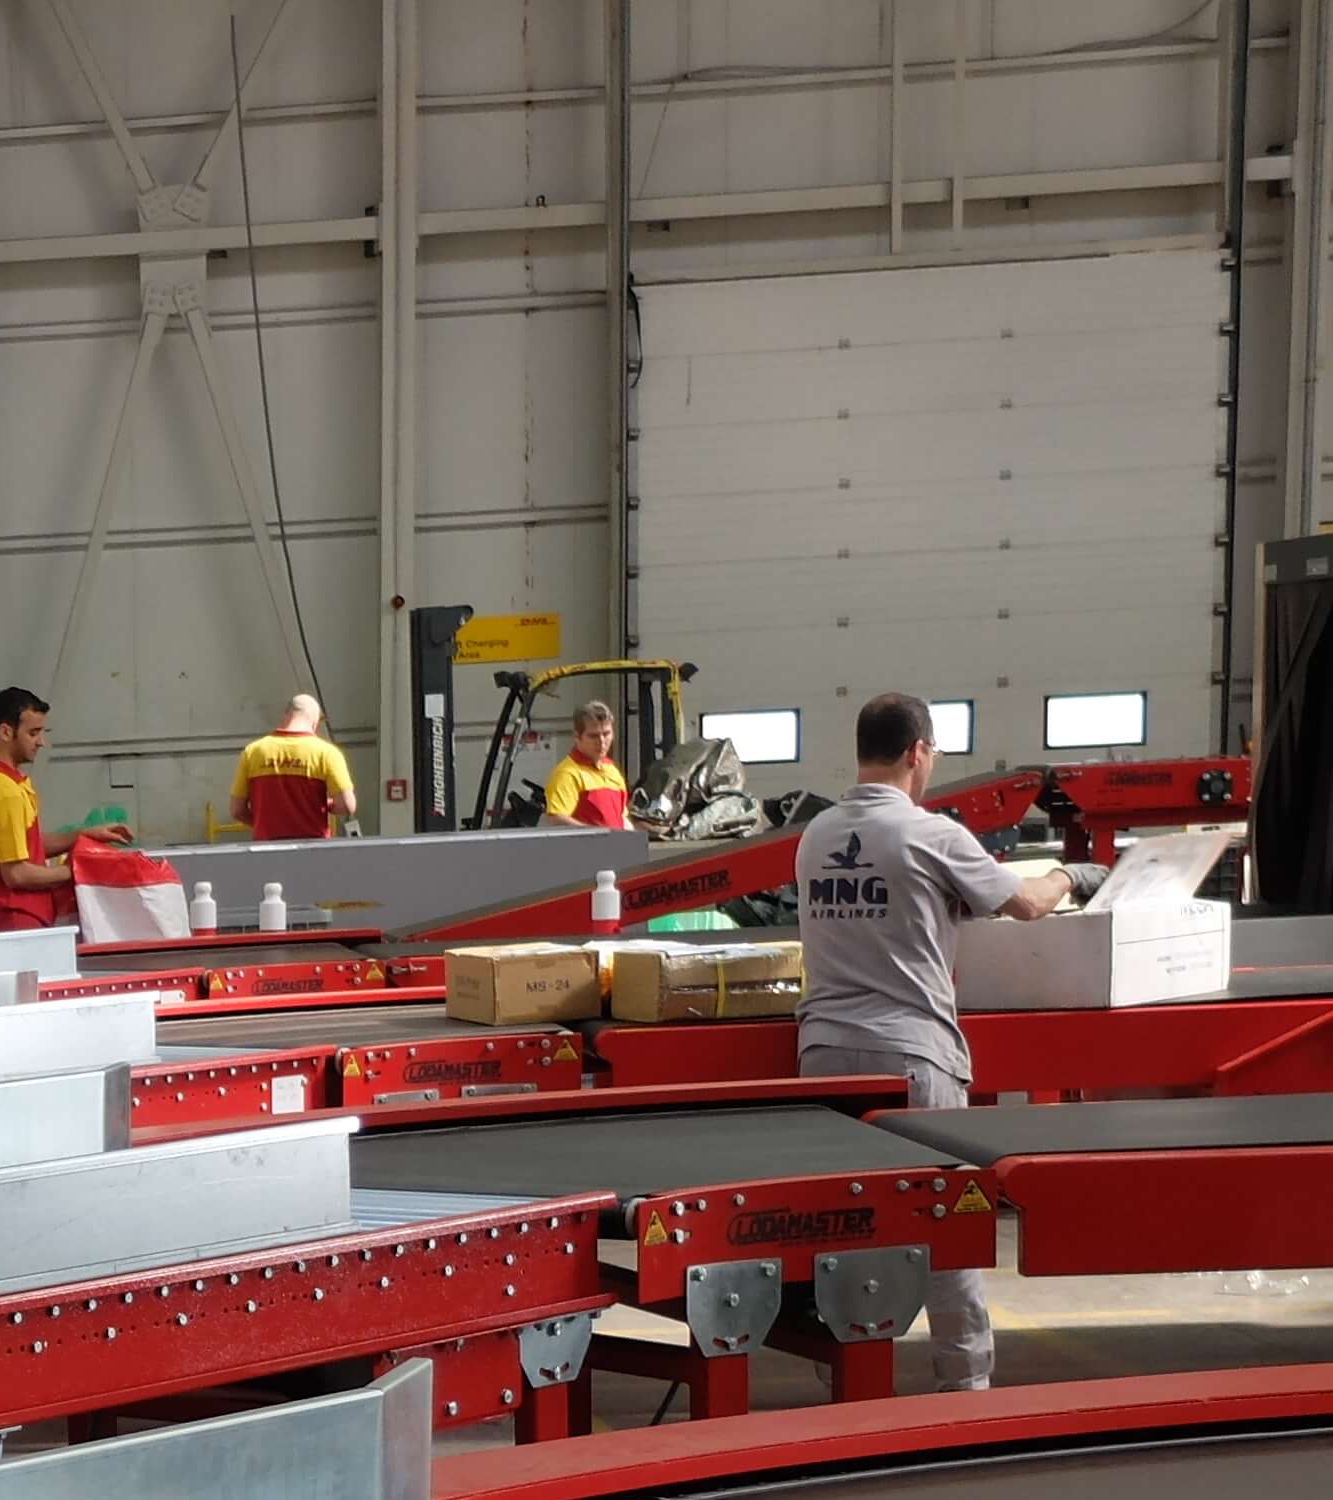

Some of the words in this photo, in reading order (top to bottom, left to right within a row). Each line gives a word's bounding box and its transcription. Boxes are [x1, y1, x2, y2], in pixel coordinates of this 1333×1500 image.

[431, 716, 445, 817] JUNGHEINRICH
[809, 876, 889, 905] MNG
[810, 908, 888, 920] AIRLINES
[729, 1206, 877, 1247] LODAMASTER
